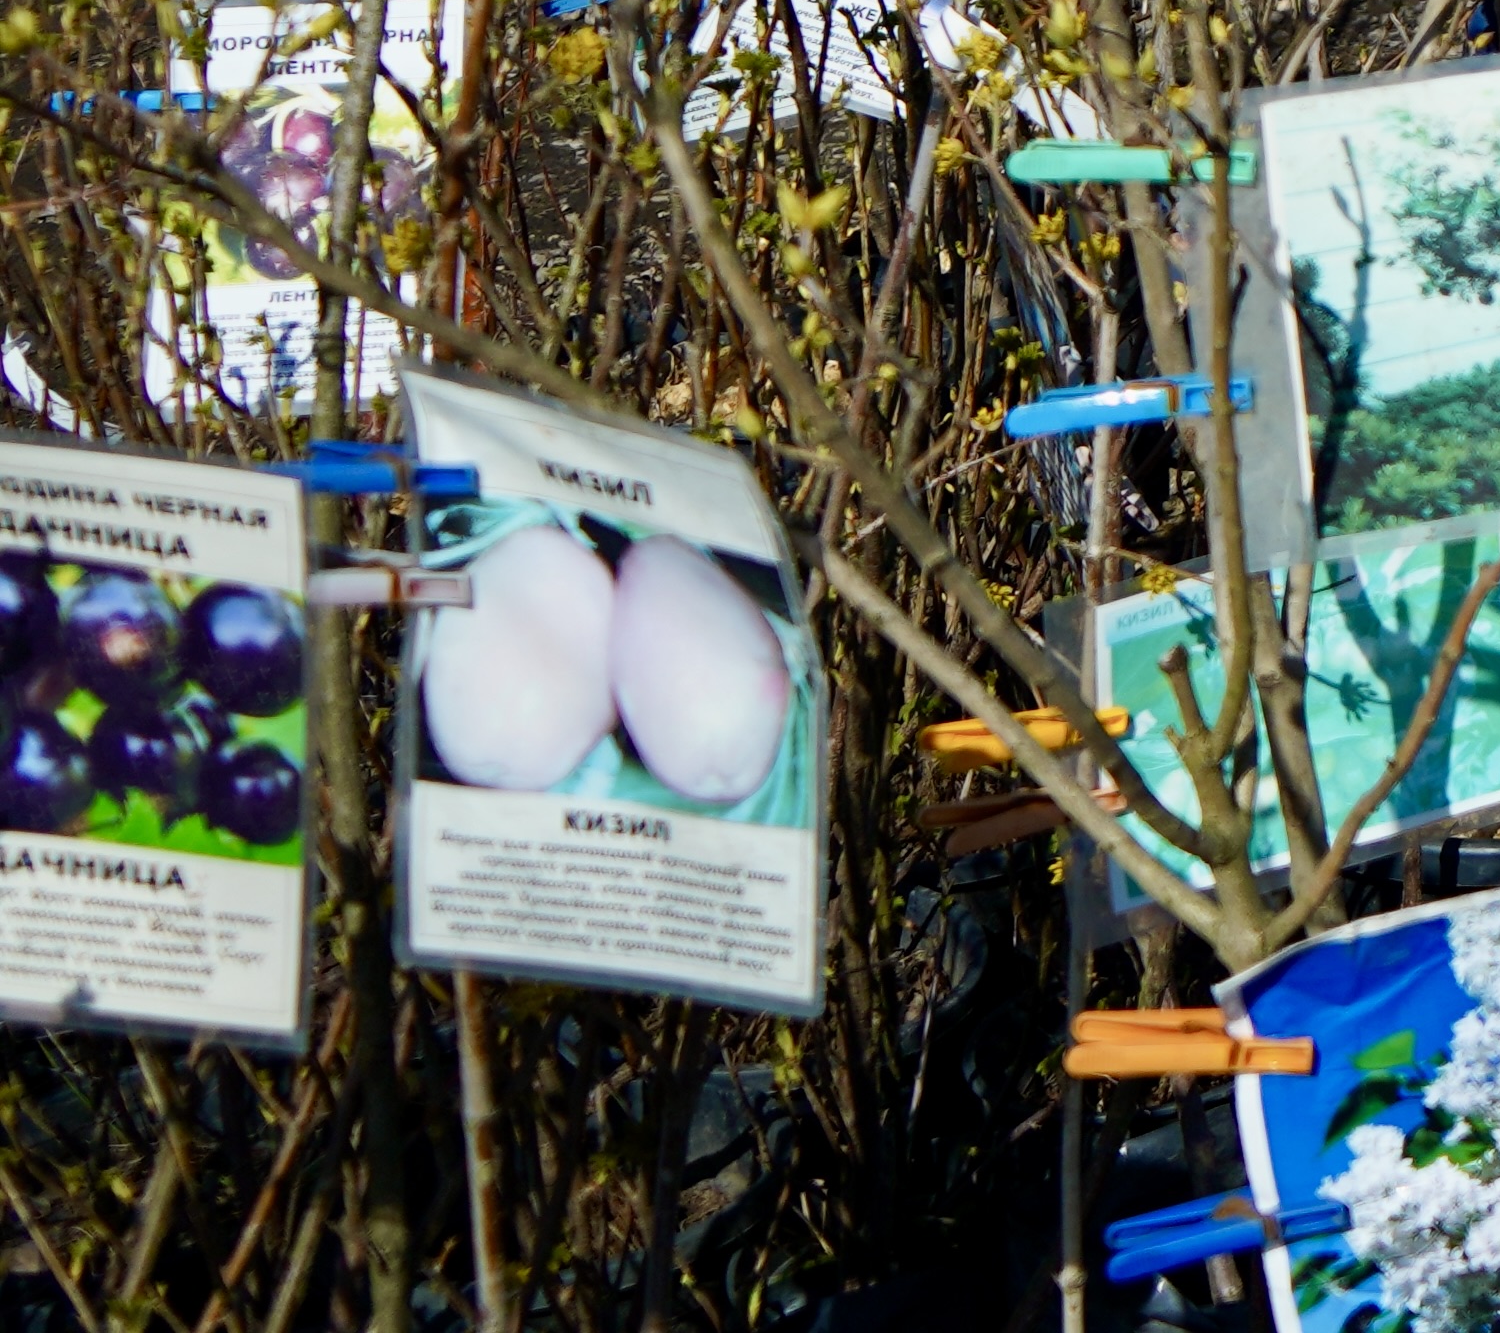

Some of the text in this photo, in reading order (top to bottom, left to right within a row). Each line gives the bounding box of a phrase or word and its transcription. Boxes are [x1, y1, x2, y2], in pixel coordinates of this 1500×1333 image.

[270, 59, 350, 75] ЛЕНТЯ
[269, 290, 318, 303] ЛЕНТ
[537, 457, 653, 506] КИЗИЛ
[131, 490, 270, 529] ЧЕРНАЯ
[1117, 600, 1174, 629] КИЗИЛ
[562, 808, 674, 841] КИЗИЛ
